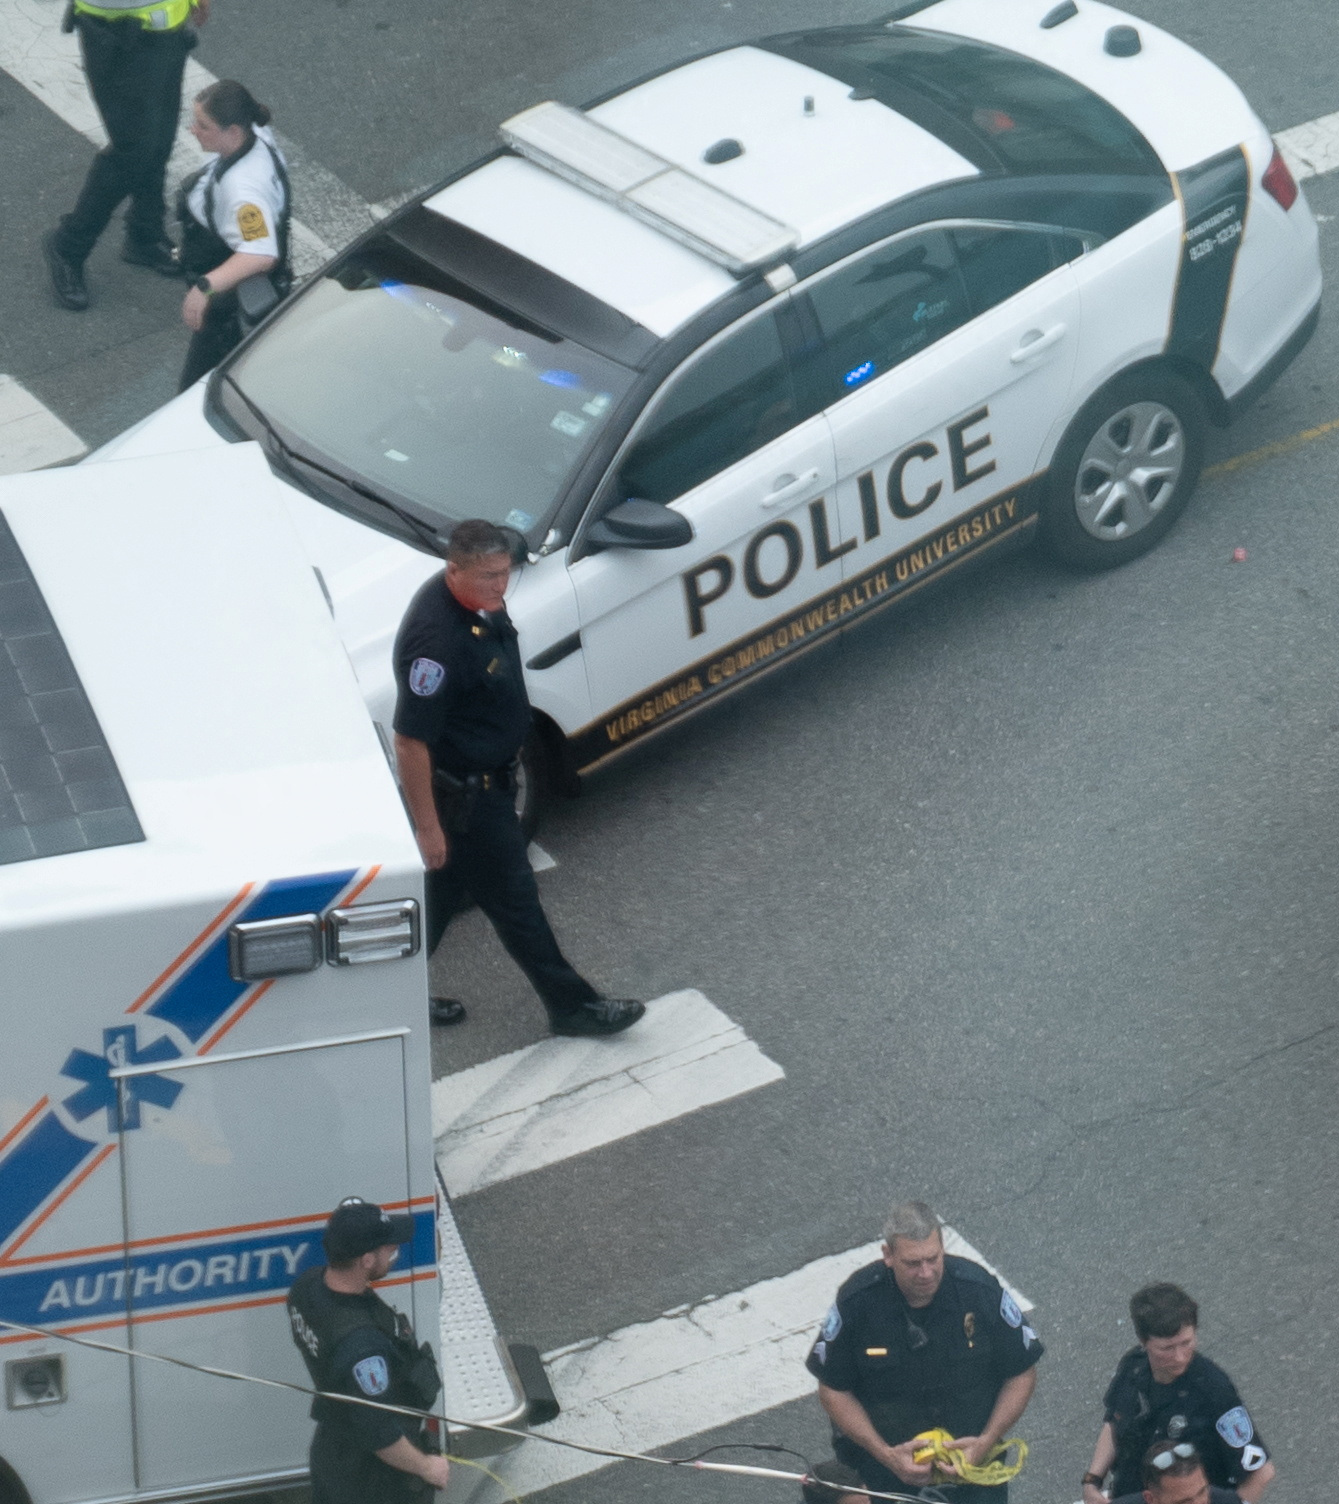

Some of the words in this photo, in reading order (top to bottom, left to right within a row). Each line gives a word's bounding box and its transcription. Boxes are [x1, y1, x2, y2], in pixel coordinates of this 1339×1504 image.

[606, 675, 703, 742] VIRGINIA
[707, 571, 888, 684] COMMONWEALTH
[895, 497, 1017, 580] UNIVERSITY
[681, 404, 997, 639] POLICE
[38, 1243, 309, 1312] AUTHORITY
